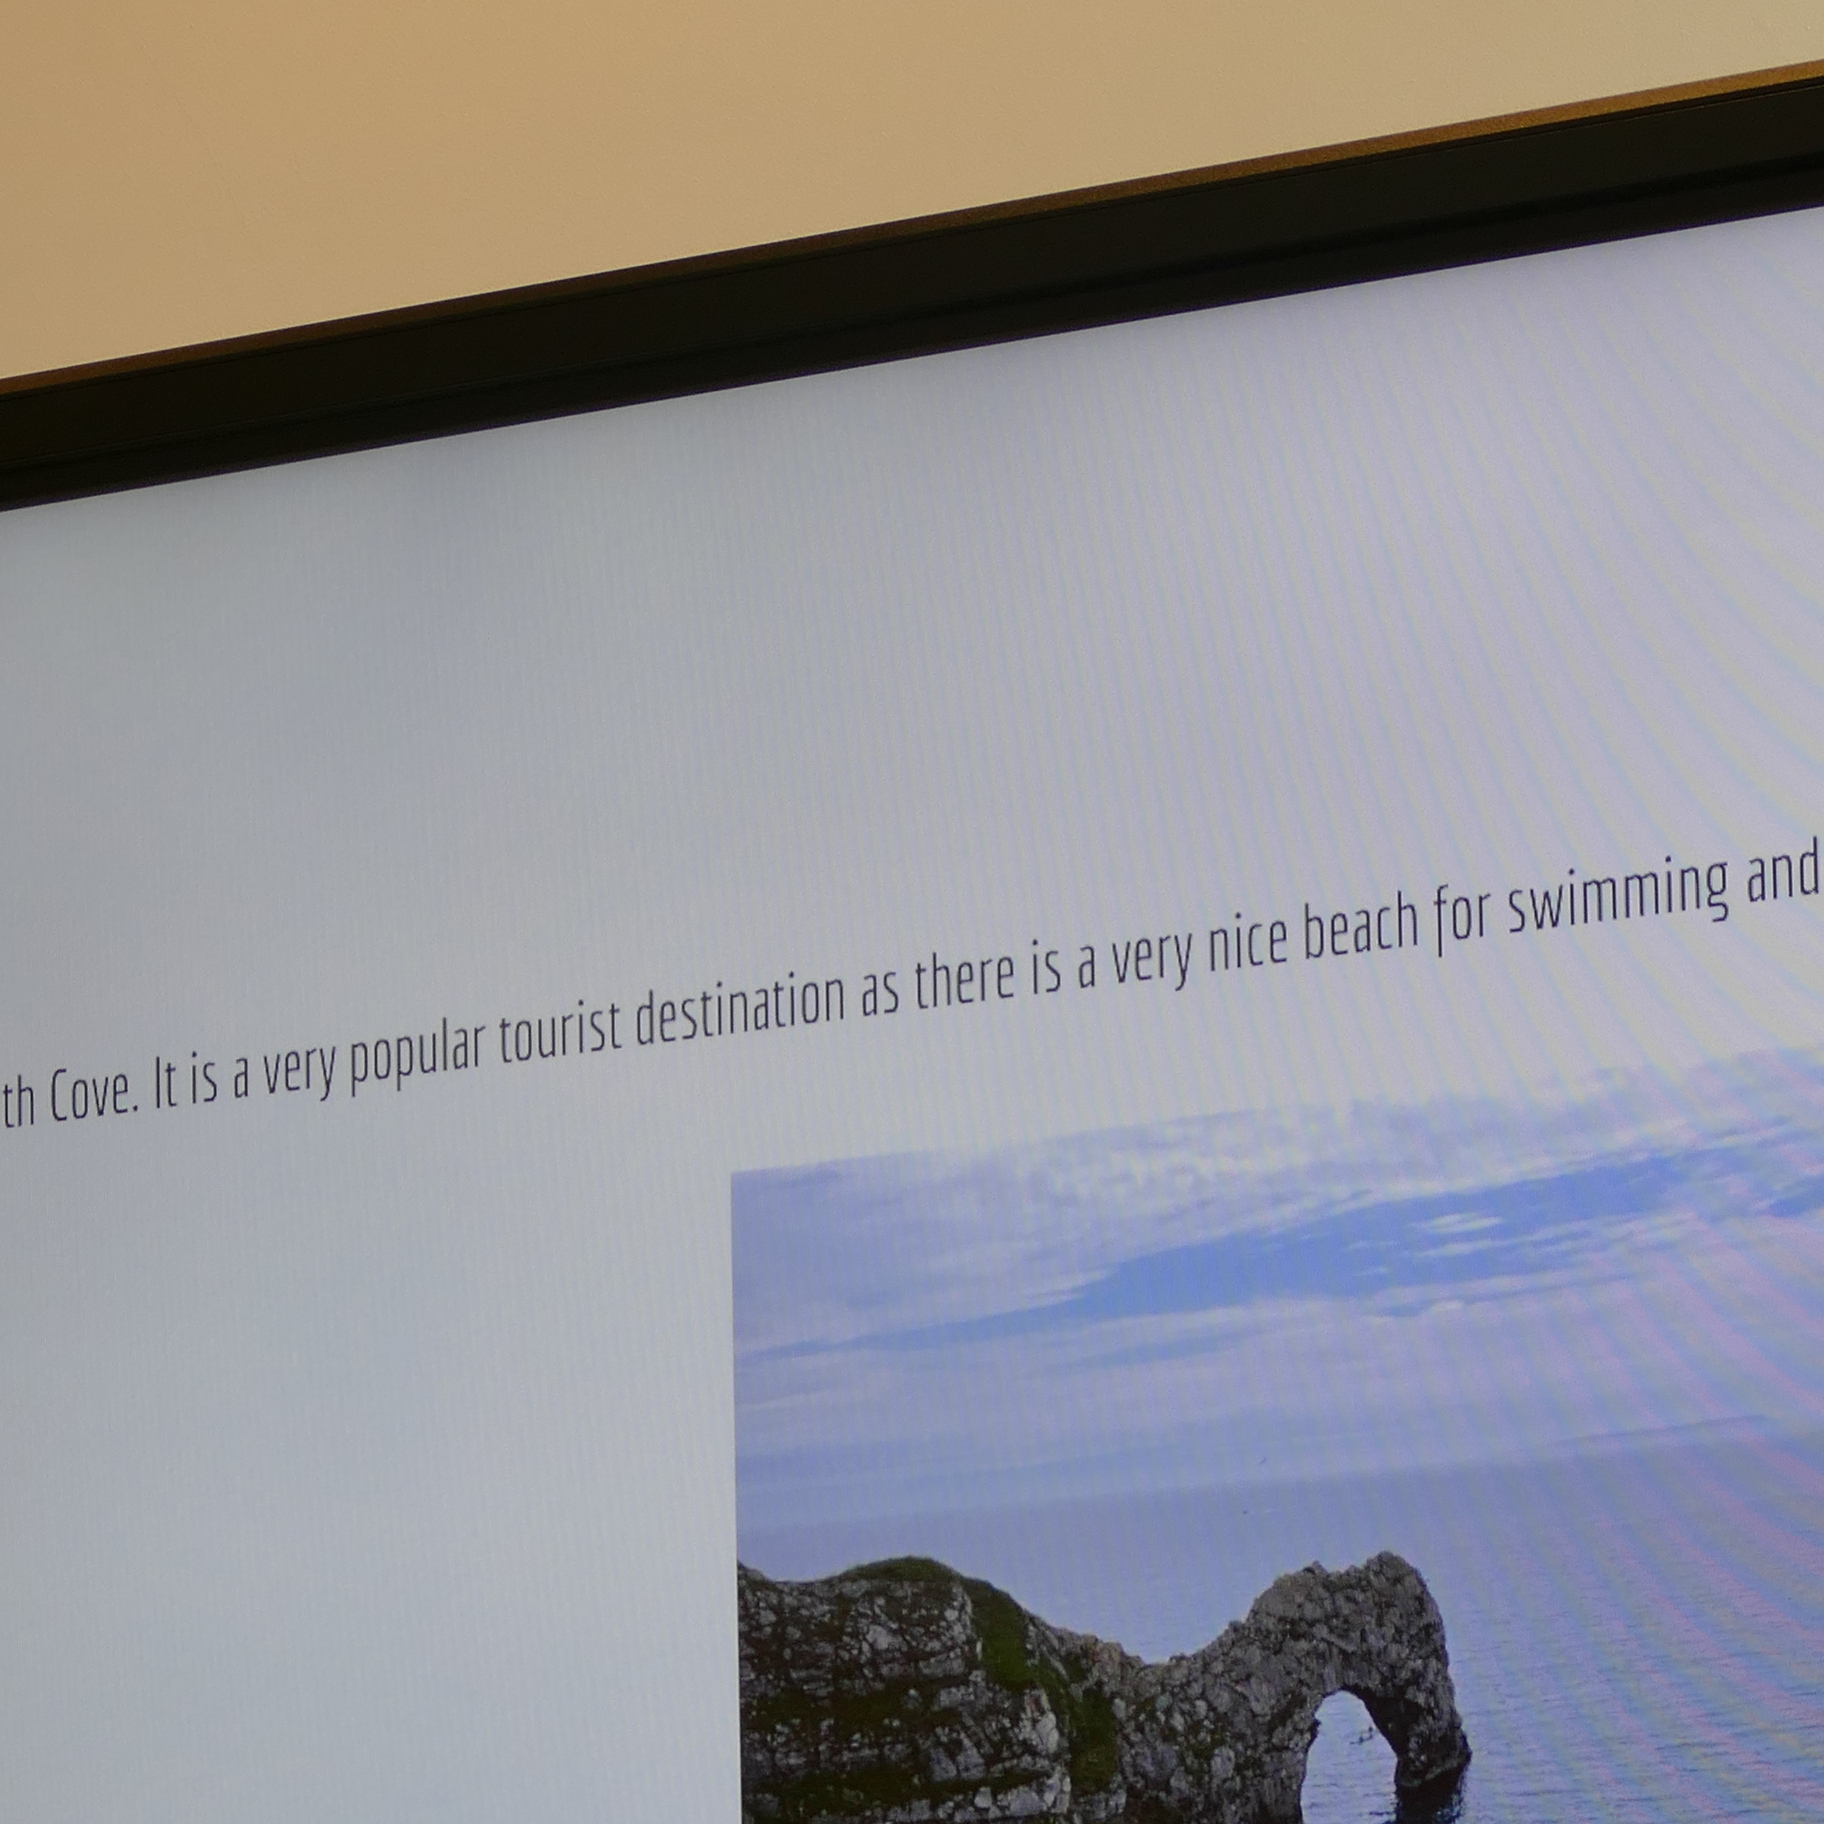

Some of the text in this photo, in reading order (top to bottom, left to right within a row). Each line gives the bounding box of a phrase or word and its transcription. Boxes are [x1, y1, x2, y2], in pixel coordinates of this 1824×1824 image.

[50, 1067, 139, 1123] Cove.
[155, 1055, 178, 1110] It
[191, 1050, 218, 1105] is
[233, 1056, 249, 1100] a
[262, 1045, 337, 1103] very
[350, 1016, 487, 1098] popular
[498, 998, 623, 1064] tourist
[636, 970, 845, 1046] destination
[861, 971, 900, 1018] as
[914, 951, 1015, 1010] there
[1031, 938, 1062, 996] is
[1077, 944, 1096, 990] a
[1111, 932, 1193, 992] very
[1209, 911, 1288, 973] nice
[1304, 889, 1419, 960] beach
[1432, 883, 1492, 959] for
[1508, 854, 1730, 934] swimming
[1747, 835, 1820, 903] and
